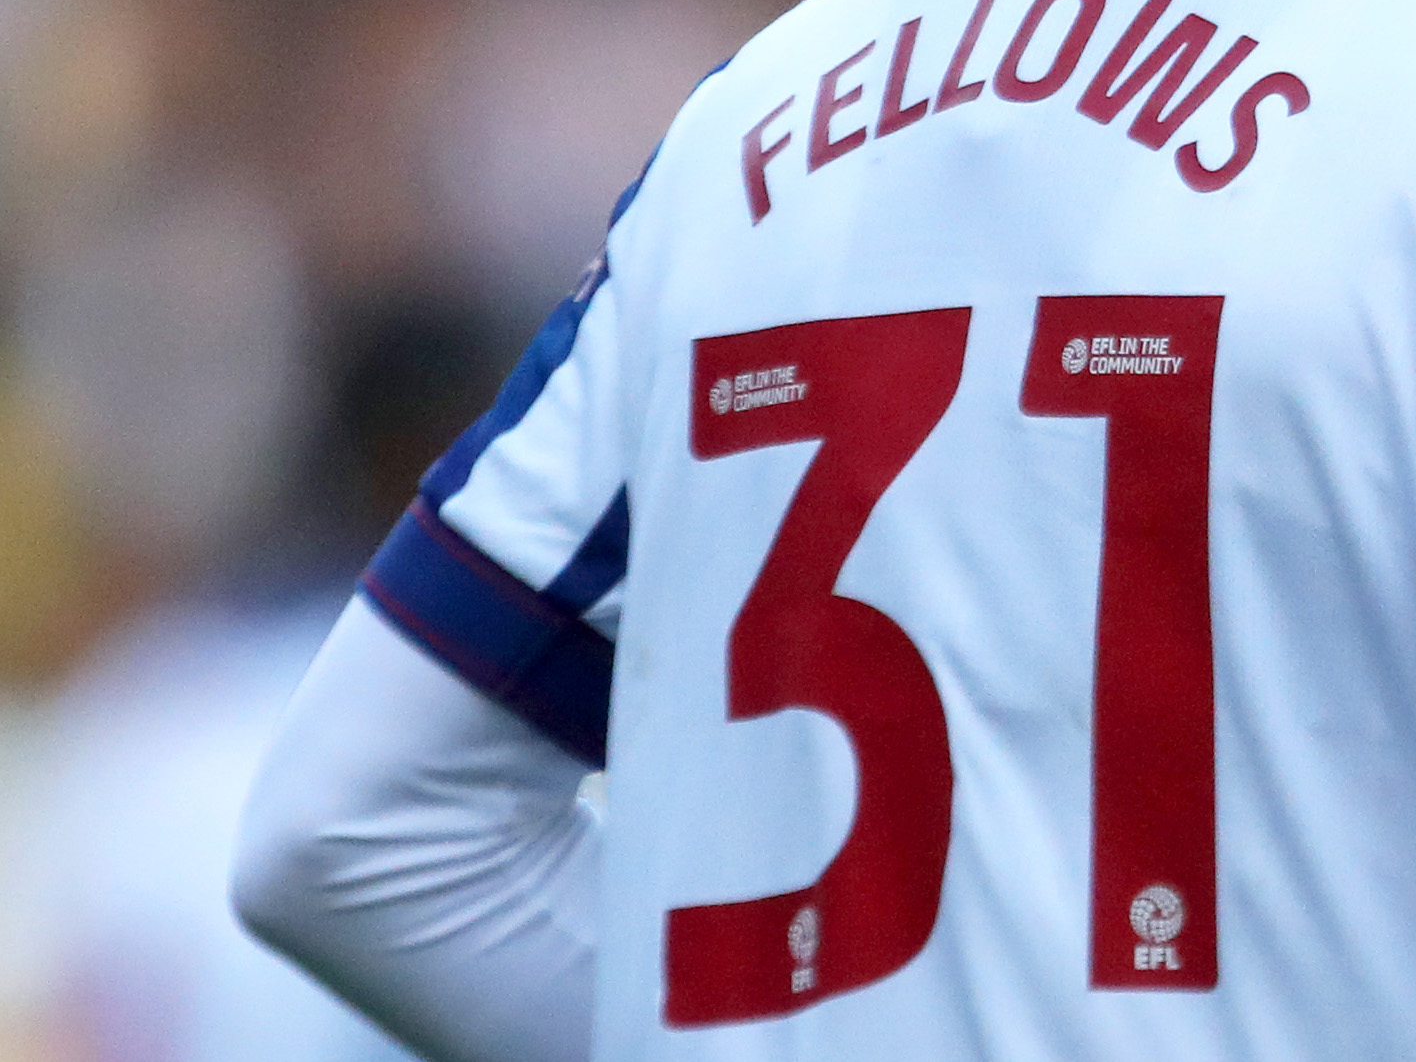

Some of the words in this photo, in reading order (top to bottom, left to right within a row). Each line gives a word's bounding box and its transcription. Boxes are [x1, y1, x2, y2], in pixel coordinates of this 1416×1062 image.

[1091, 337, 1116, 355] EFL
[1118, 337, 1137, 355] IN
[1140, 337, 1170, 355] THE
[1089, 357, 1182, 375] COMMUNITY
[734, 374, 756, 392] EFL
[770, 366, 796, 385] THE
[733, 383, 807, 412] COMMUNITY
[663, 295, 1225, 1030] 31
[1134, 946, 1181, 971] EFL
